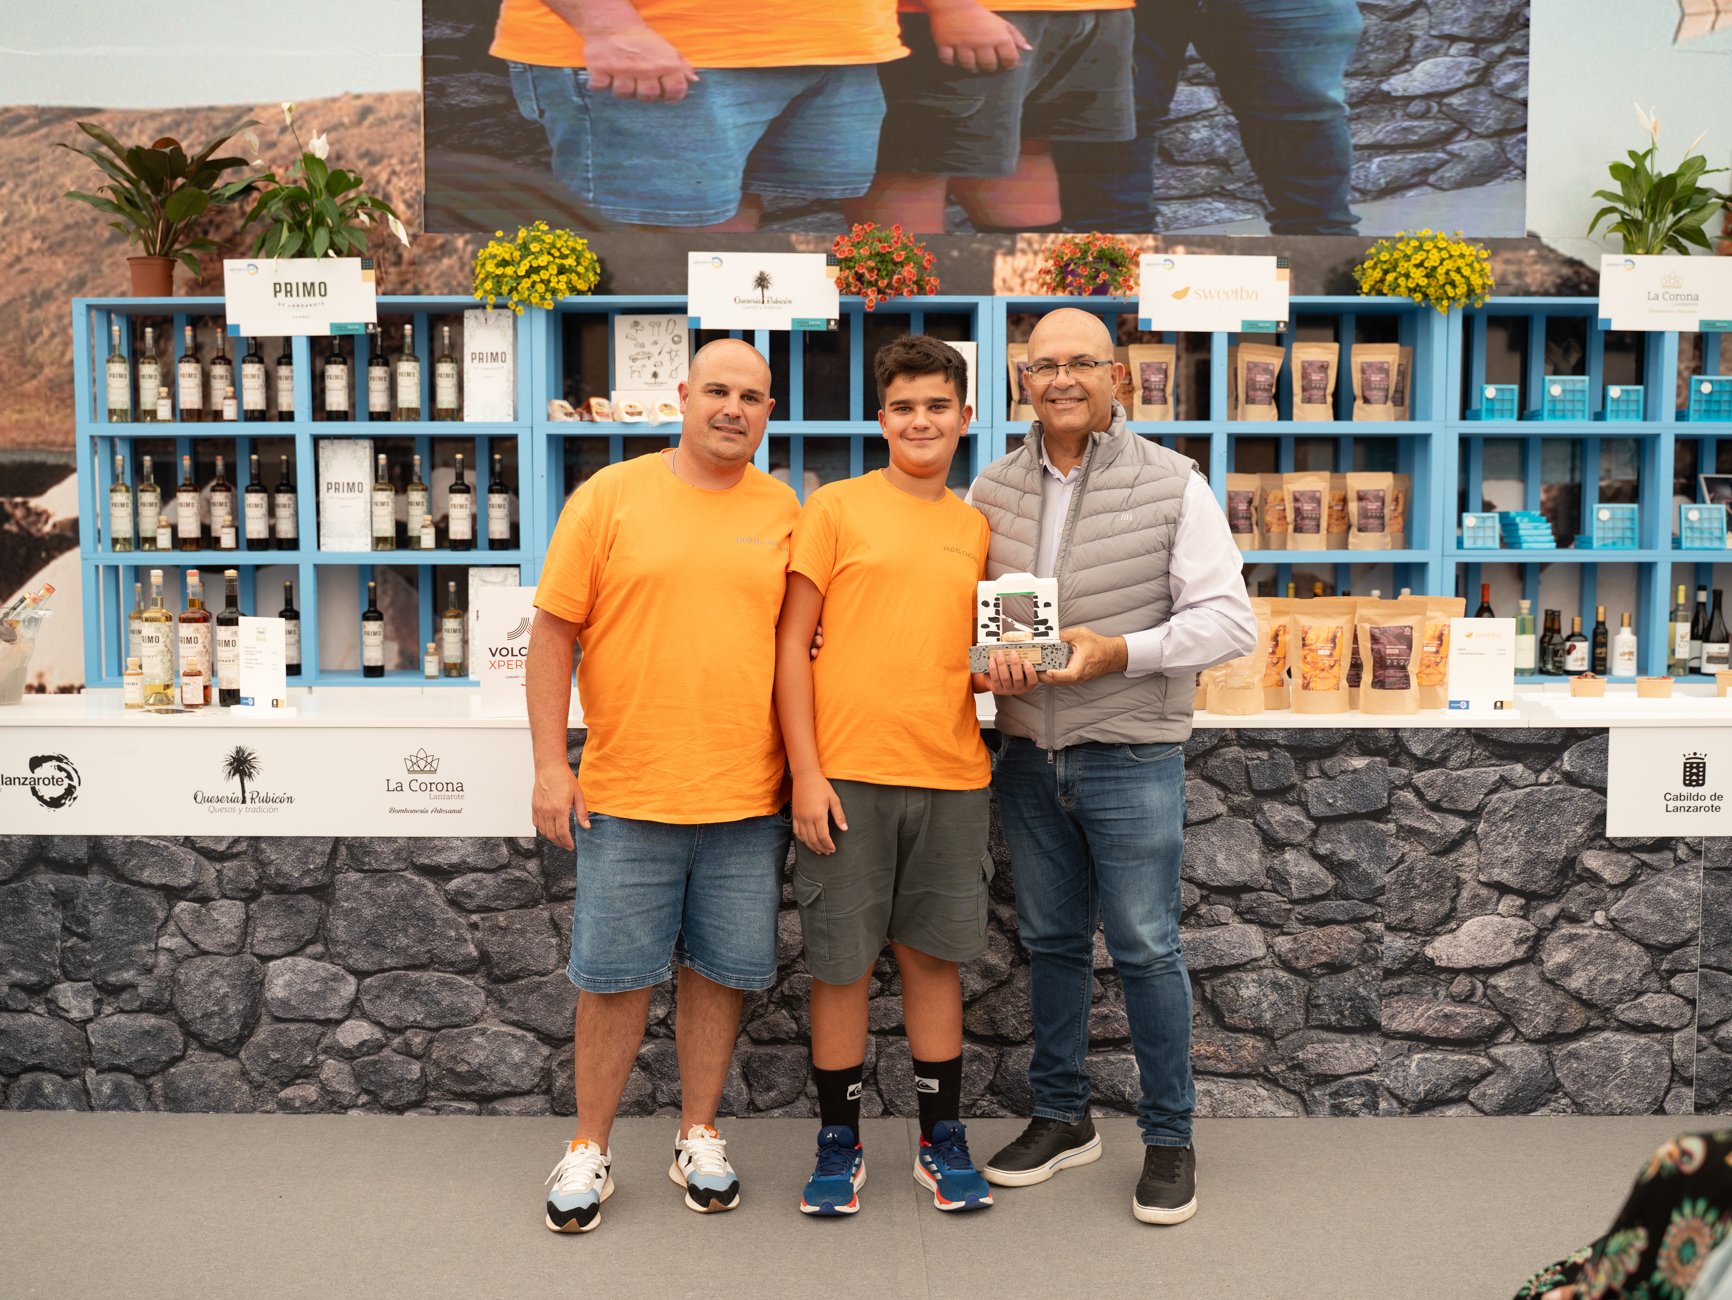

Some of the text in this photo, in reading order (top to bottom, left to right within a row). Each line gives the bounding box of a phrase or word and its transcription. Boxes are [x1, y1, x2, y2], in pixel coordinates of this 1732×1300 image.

[273, 281, 328, 298] PRIMO
[1194, 286, 1259, 301] sweetba
[1647, 291, 1699, 301] La Corona
[471, 351, 507, 364] PRIMO
[326, 482, 364, 493] PRIMO
[488, 646, 528, 658] VOLC
[488, 660, 528, 670] XPERI
[0, 774, 65, 786] lanzarote
[386, 779, 465, 792] La Corona
[193, 790, 295, 804] Quesería Rubicón
[1663, 792, 1724, 802] Cabildo de
[208, 805, 236, 814] Quesos
[245, 805, 279, 814] tradición
[1665, 803, 1721, 813] Lanzarote
